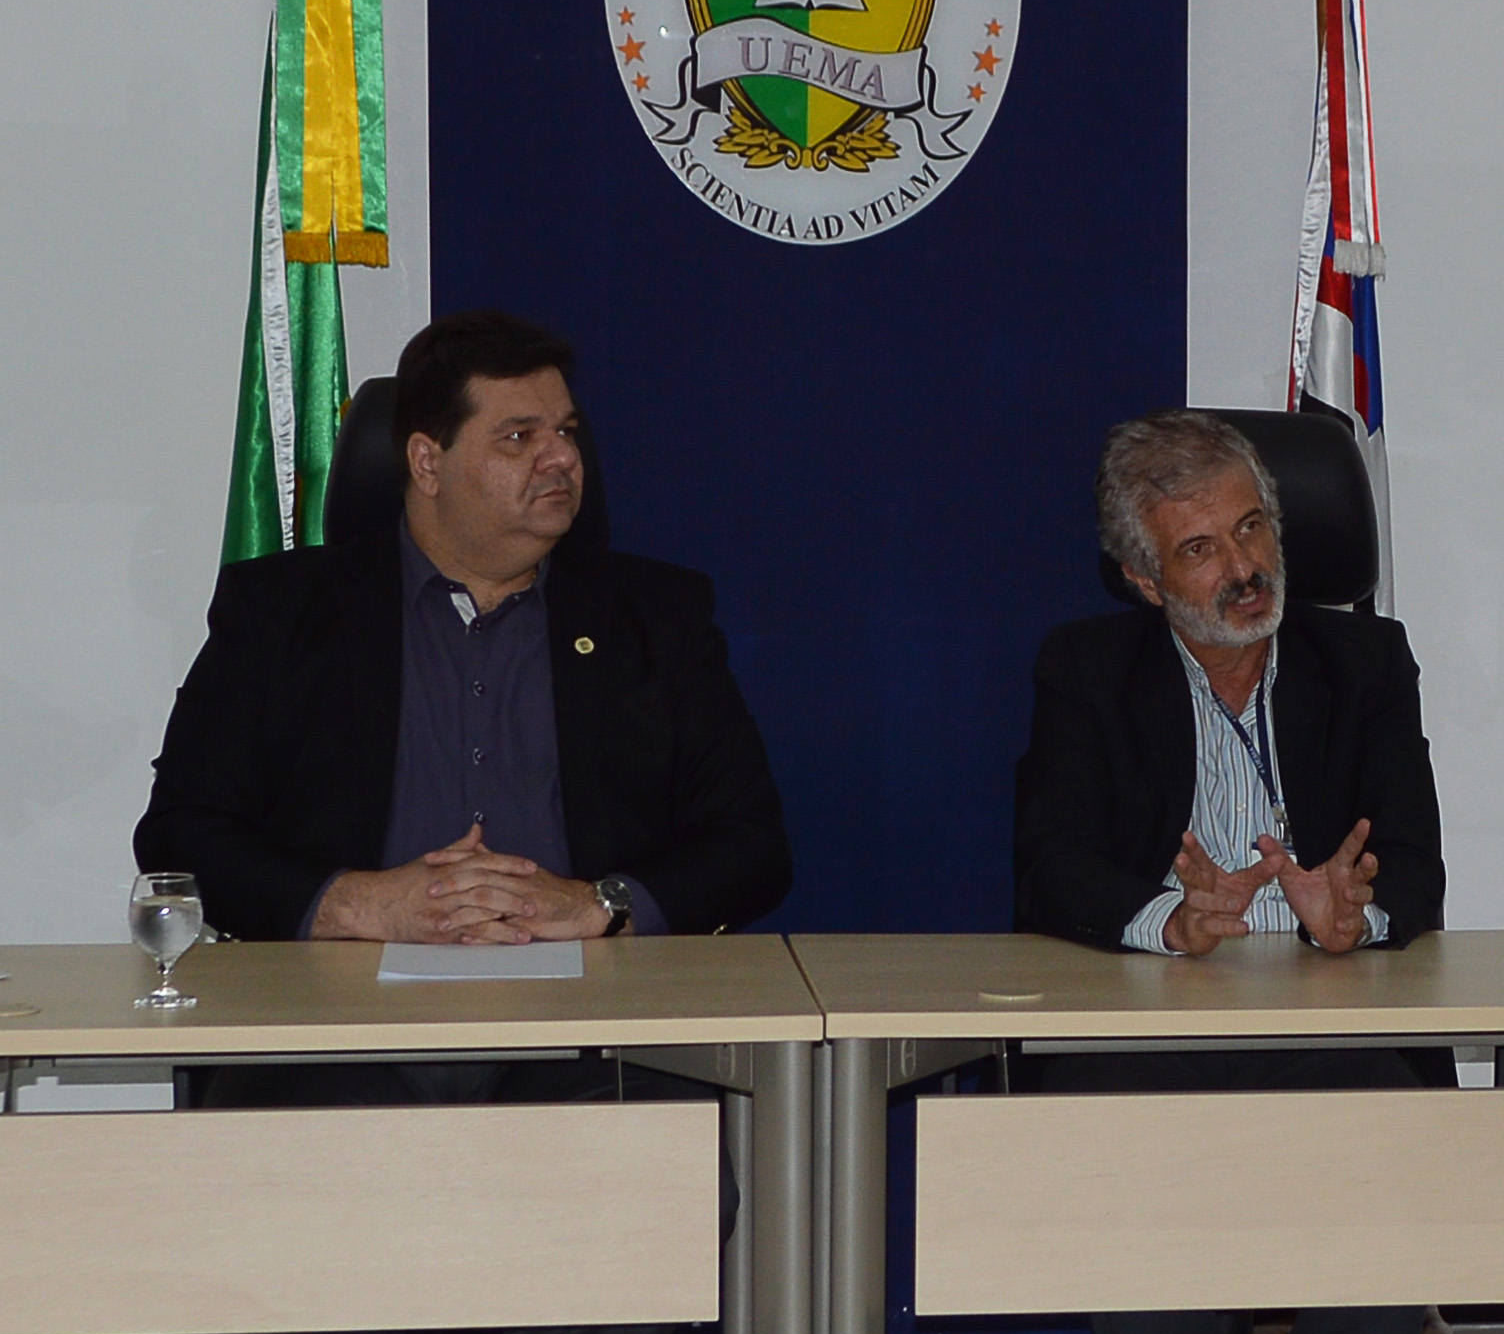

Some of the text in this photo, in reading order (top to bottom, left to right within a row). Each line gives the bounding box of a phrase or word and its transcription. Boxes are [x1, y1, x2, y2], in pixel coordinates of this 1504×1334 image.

[737, 36, 888, 103] UEMA
[670, 147, 940, 240] SCIENTIA AD VITAM
